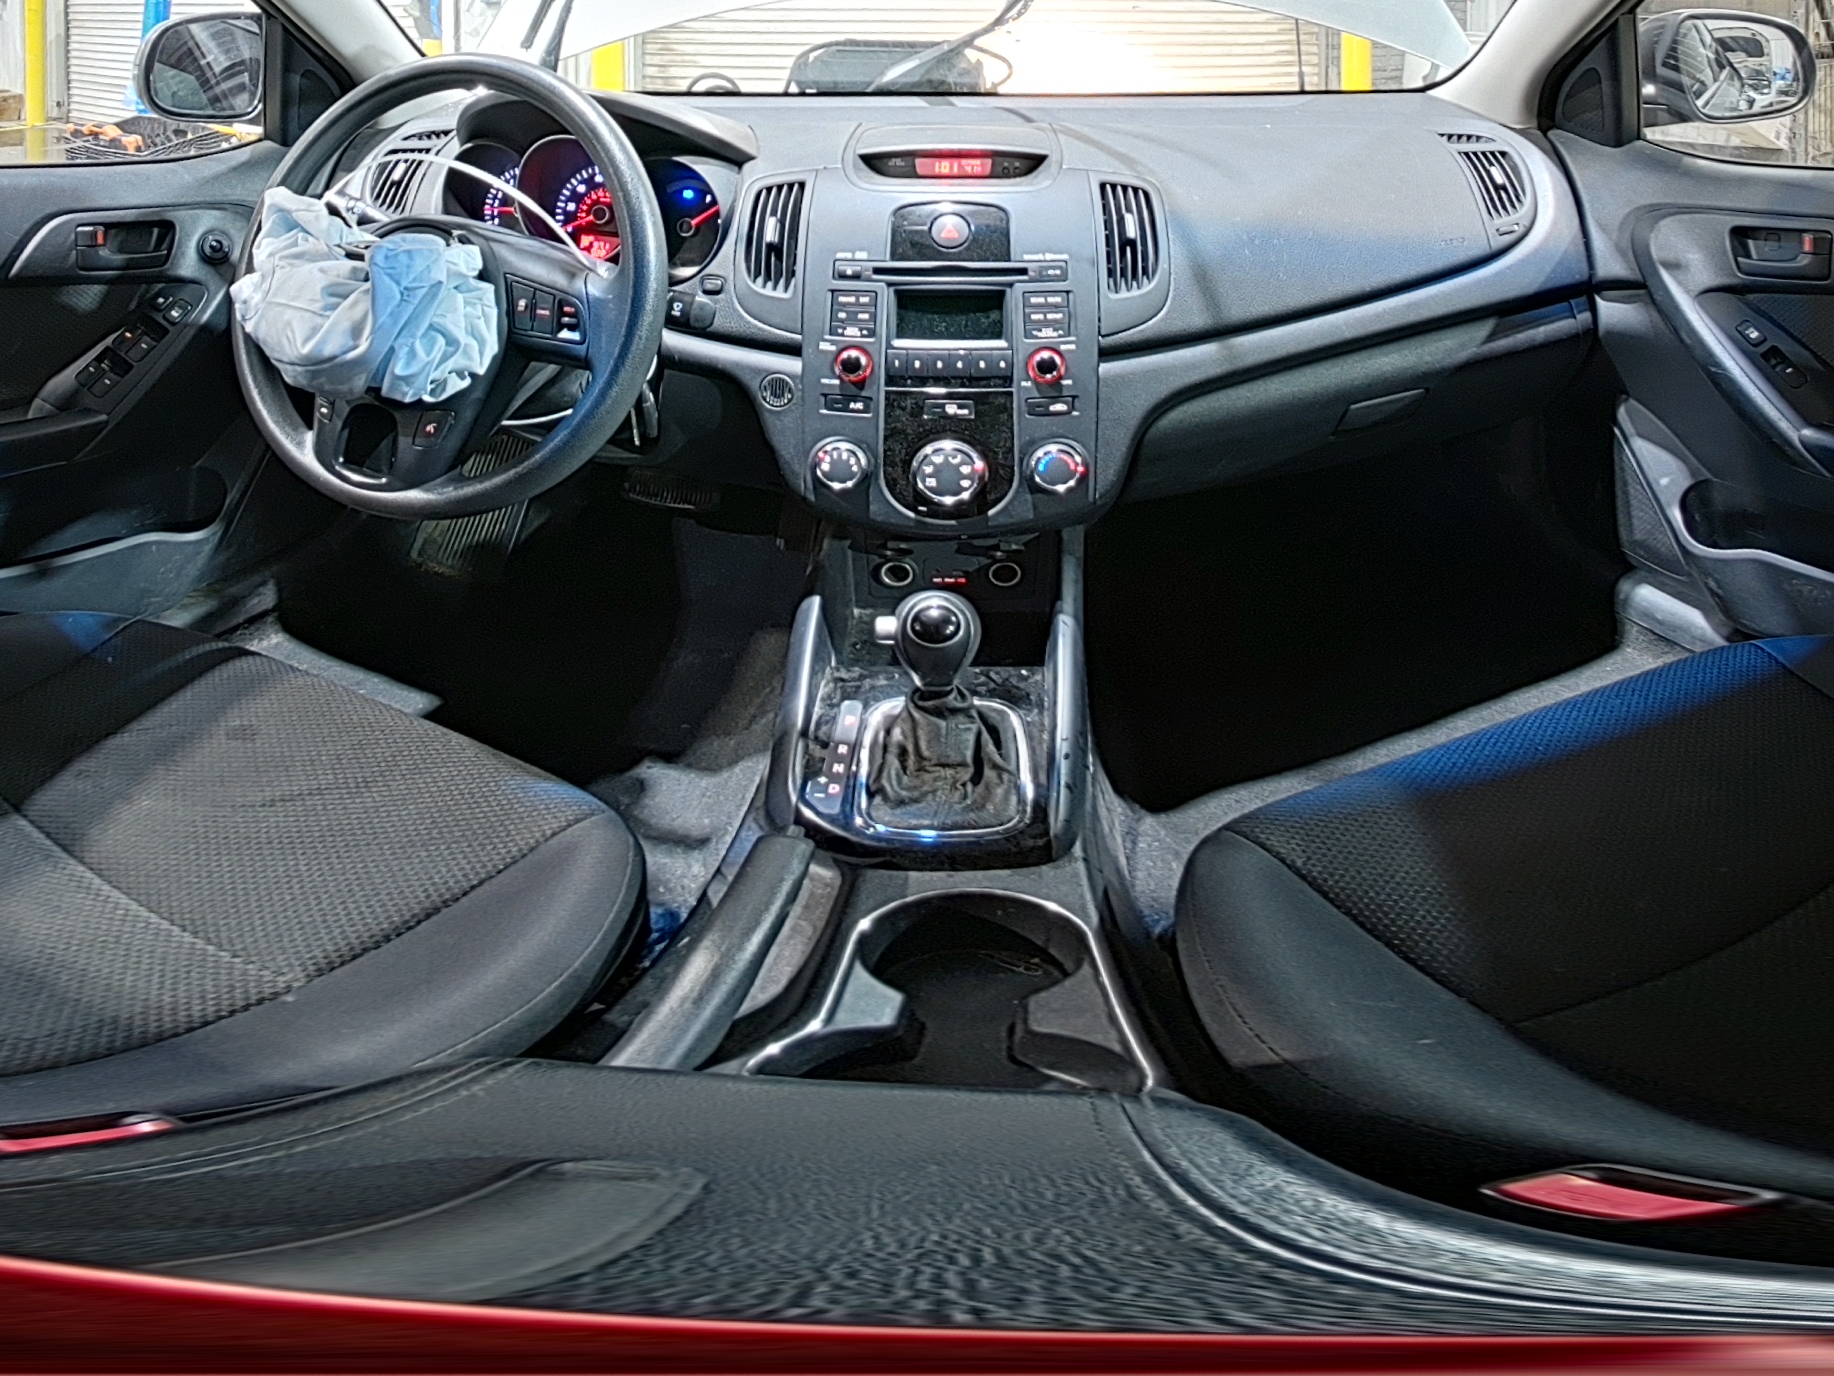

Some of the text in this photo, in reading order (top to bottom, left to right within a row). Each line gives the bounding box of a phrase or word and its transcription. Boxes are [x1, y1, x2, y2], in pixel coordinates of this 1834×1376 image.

[894, 359, 900, 369] 1
[849, 401, 864, 410] A/C
[836, 744, 849, 755] R
[832, 762, 845, 774] N
[827, 783, 840, 794] D
